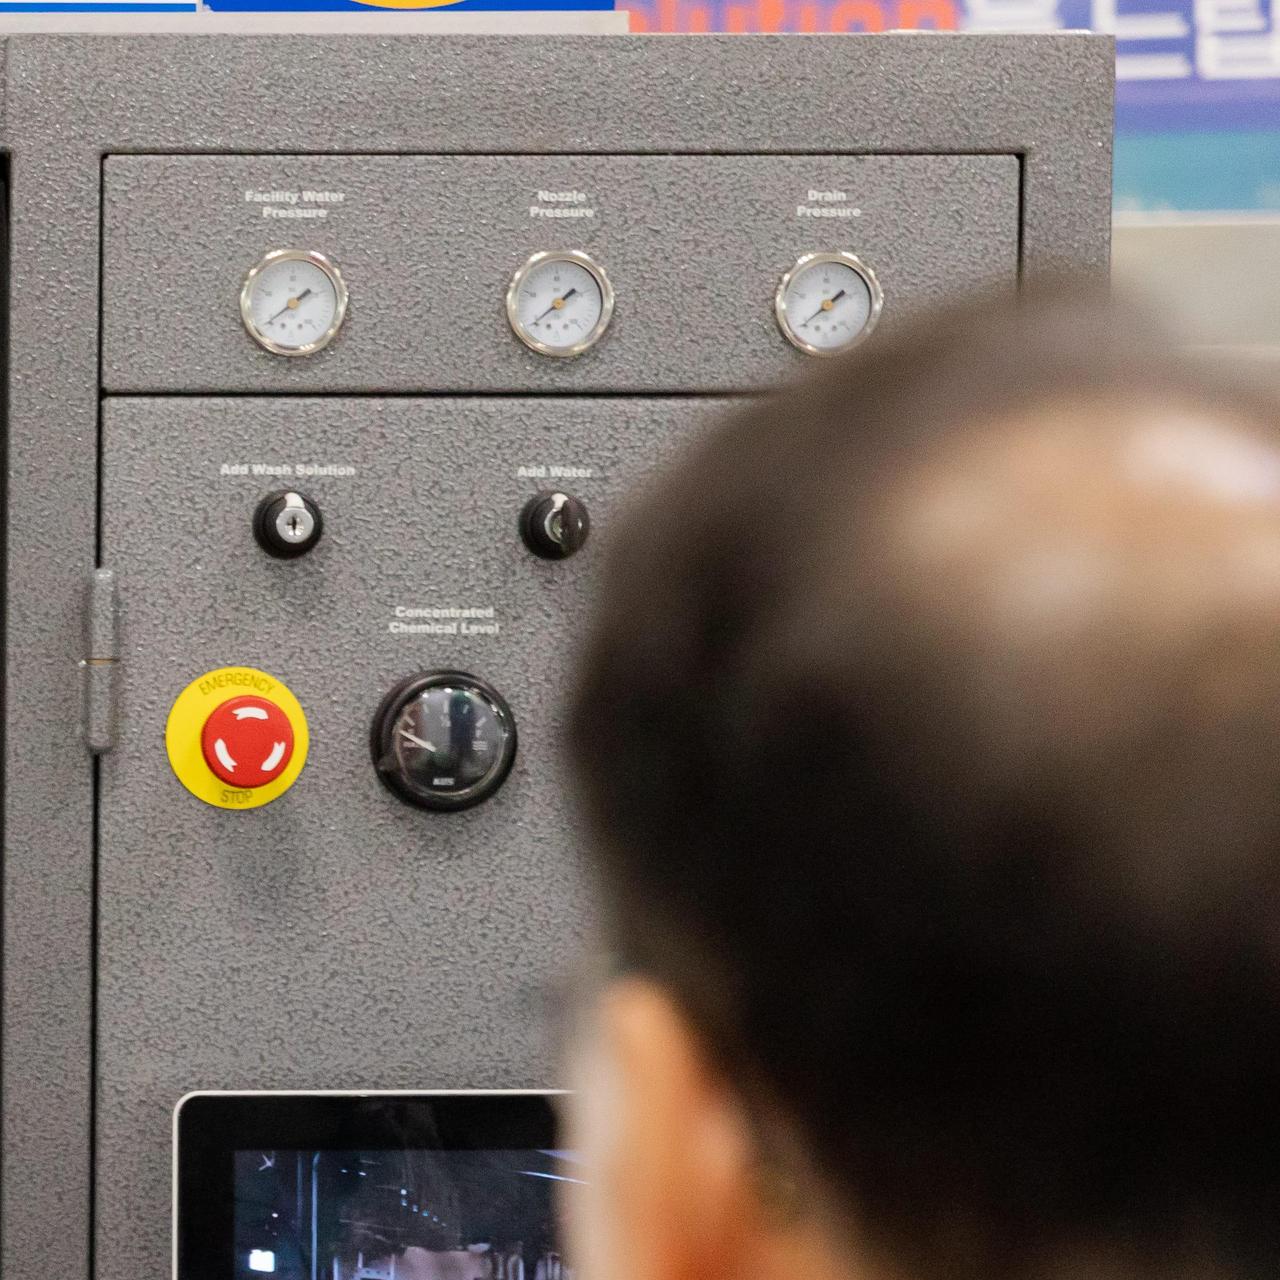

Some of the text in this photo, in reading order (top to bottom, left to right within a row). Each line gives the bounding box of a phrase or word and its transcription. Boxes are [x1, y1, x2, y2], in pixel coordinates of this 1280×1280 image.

[245, 190, 345, 205] Facility Water
[538, 190, 587, 202] Nozzle
[807, 190, 847, 201] Drain
[262, 207, 328, 218] Pressure
[530, 206, 594, 218] Pressure
[797, 206, 861, 218] Pressure
[220, 463, 356, 476] Add Wash Solution
[518, 465, 592, 478] Add Water
[395, 606, 495, 618] Concentrated
[389, 622, 500, 634] Chemical Level
[198, 672, 274, 696] EMERGENCY
[220, 789, 253, 804] STOP
